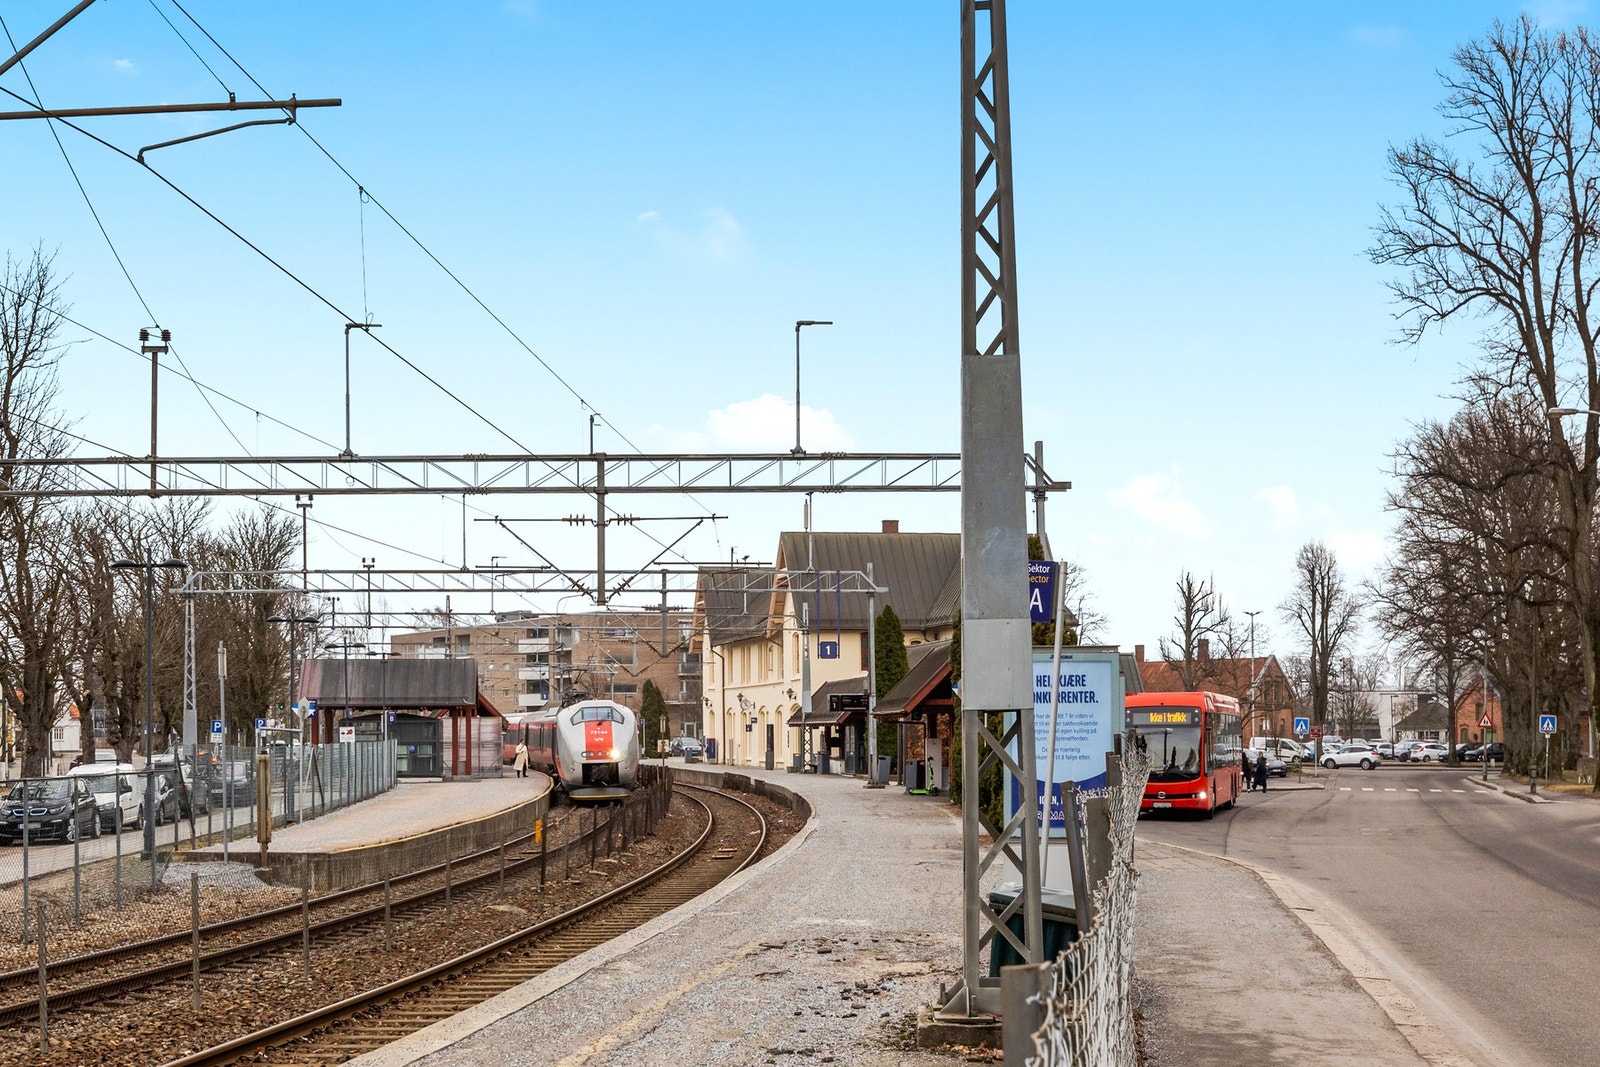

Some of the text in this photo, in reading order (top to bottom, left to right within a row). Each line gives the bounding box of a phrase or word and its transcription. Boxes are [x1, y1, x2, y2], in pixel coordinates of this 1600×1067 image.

[1028, 563, 1050, 573] Sektor
[1030, 588, 1043, 613] A
[825, 645, 831, 656] 1
[214, 721, 222, 732] P
